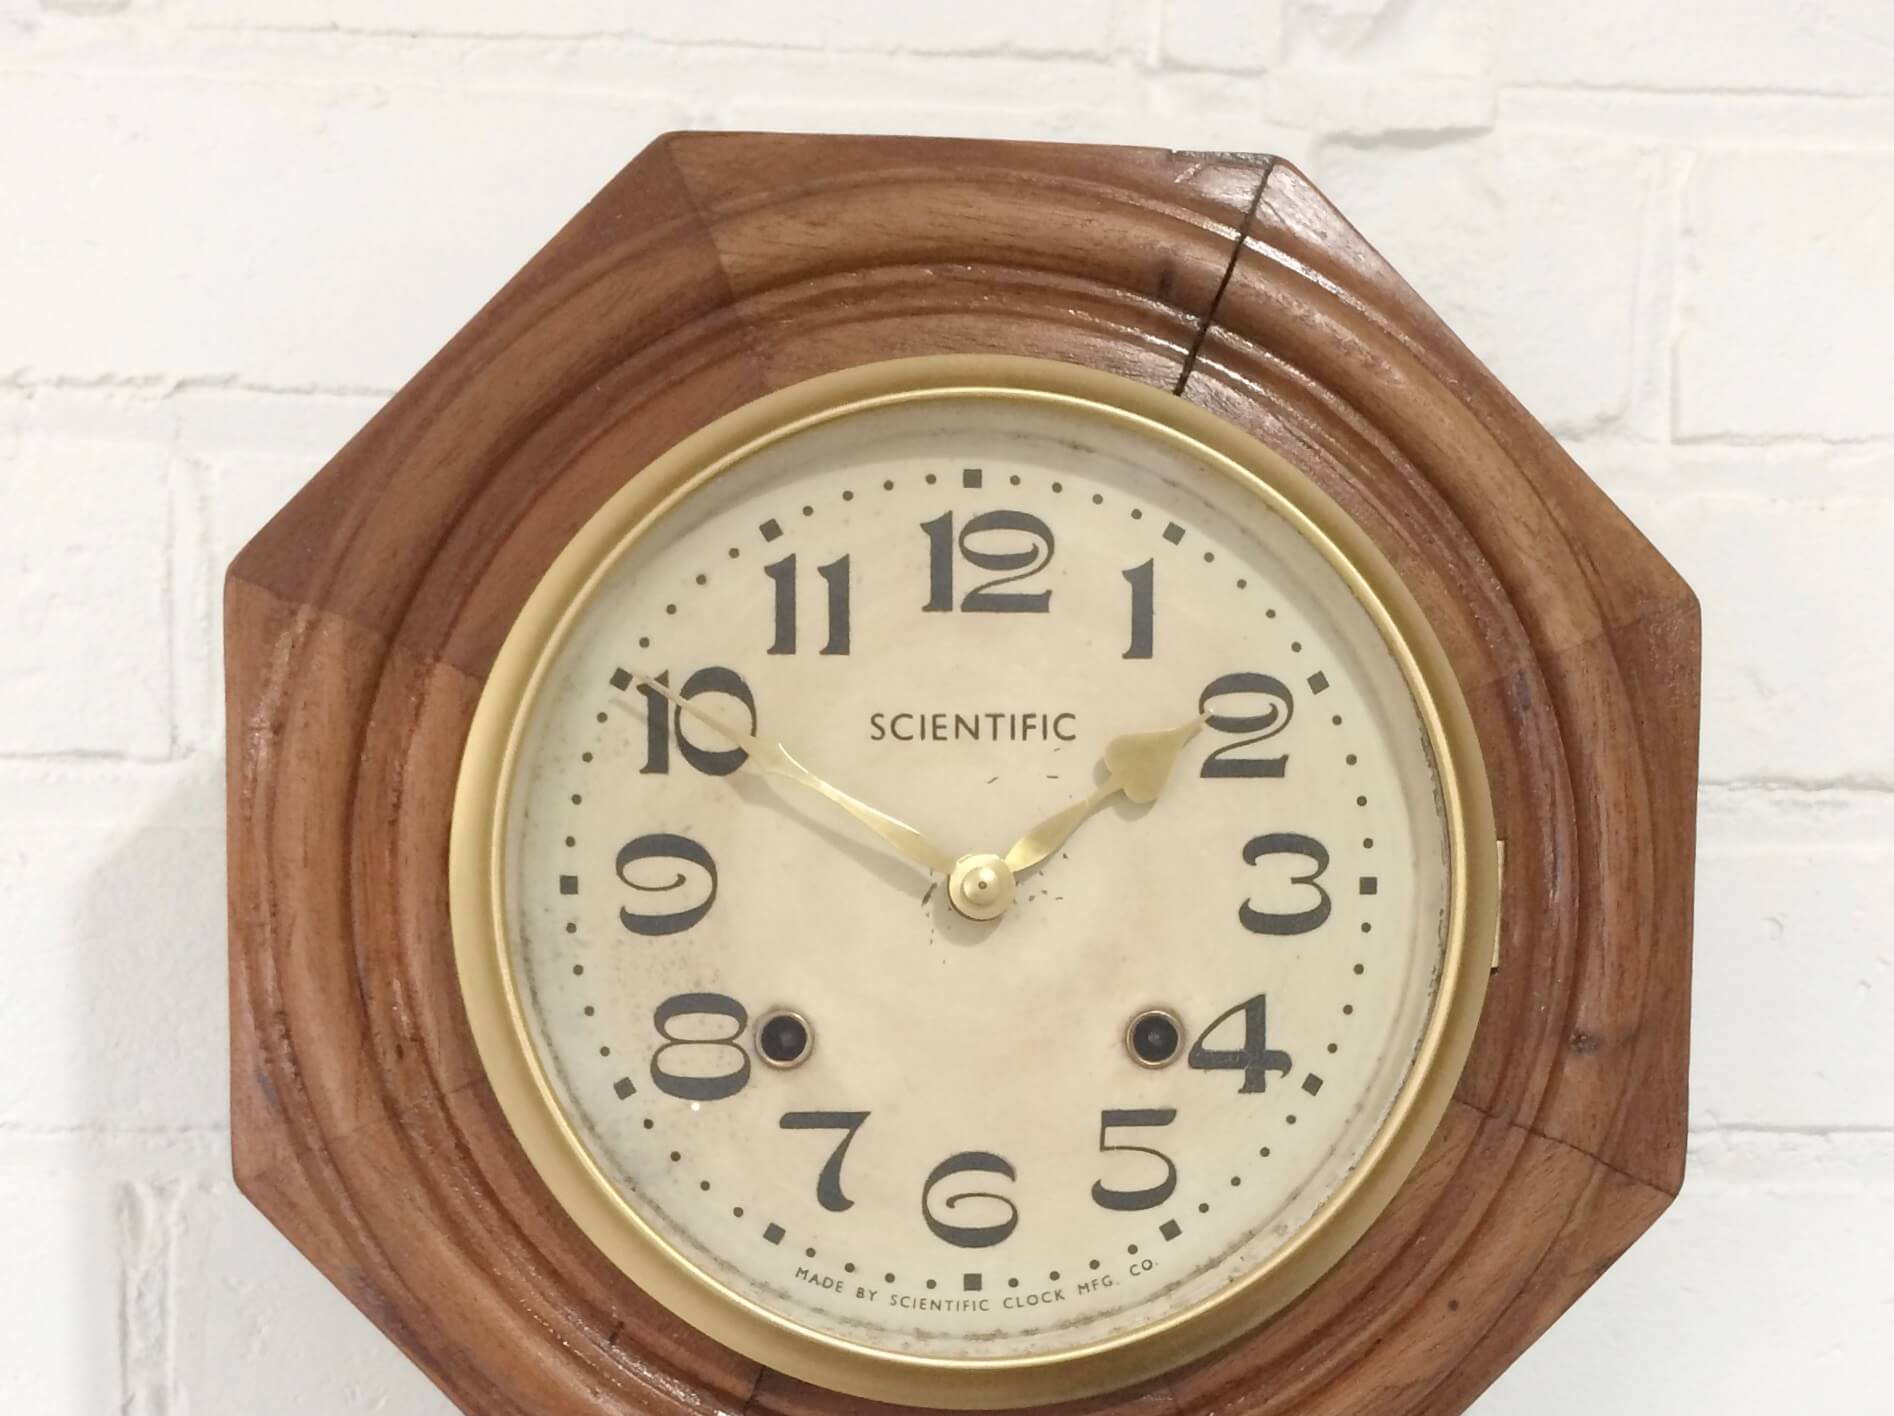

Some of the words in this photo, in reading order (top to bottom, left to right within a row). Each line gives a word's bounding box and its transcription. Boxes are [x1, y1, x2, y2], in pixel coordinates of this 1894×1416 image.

[765, 553, 852, 656] 11
[921, 509, 1055, 614] 12
[1122, 557, 1156, 660] 1
[636, 666, 758, 776] 10
[869, 711, 1078, 742] SCIENTIFIC
[1199, 671, 1295, 778] 2
[615, 834, 718, 936] 9
[1238, 834, 1332, 936] 3
[652, 992, 752, 1102] 8
[1187, 993, 1293, 1095] 4
[778, 1110, 871, 1213] 7
[921, 1150, 1019, 1248] 6
[1090, 1108, 1179, 1212] 5
[796, 1267, 844, 1293] MADE
[855, 1286, 878, 1302] BY
[889, 1294, 990, 1312] SCIENTIFIC
[1003, 1288, 1065, 1310] CLOCK
